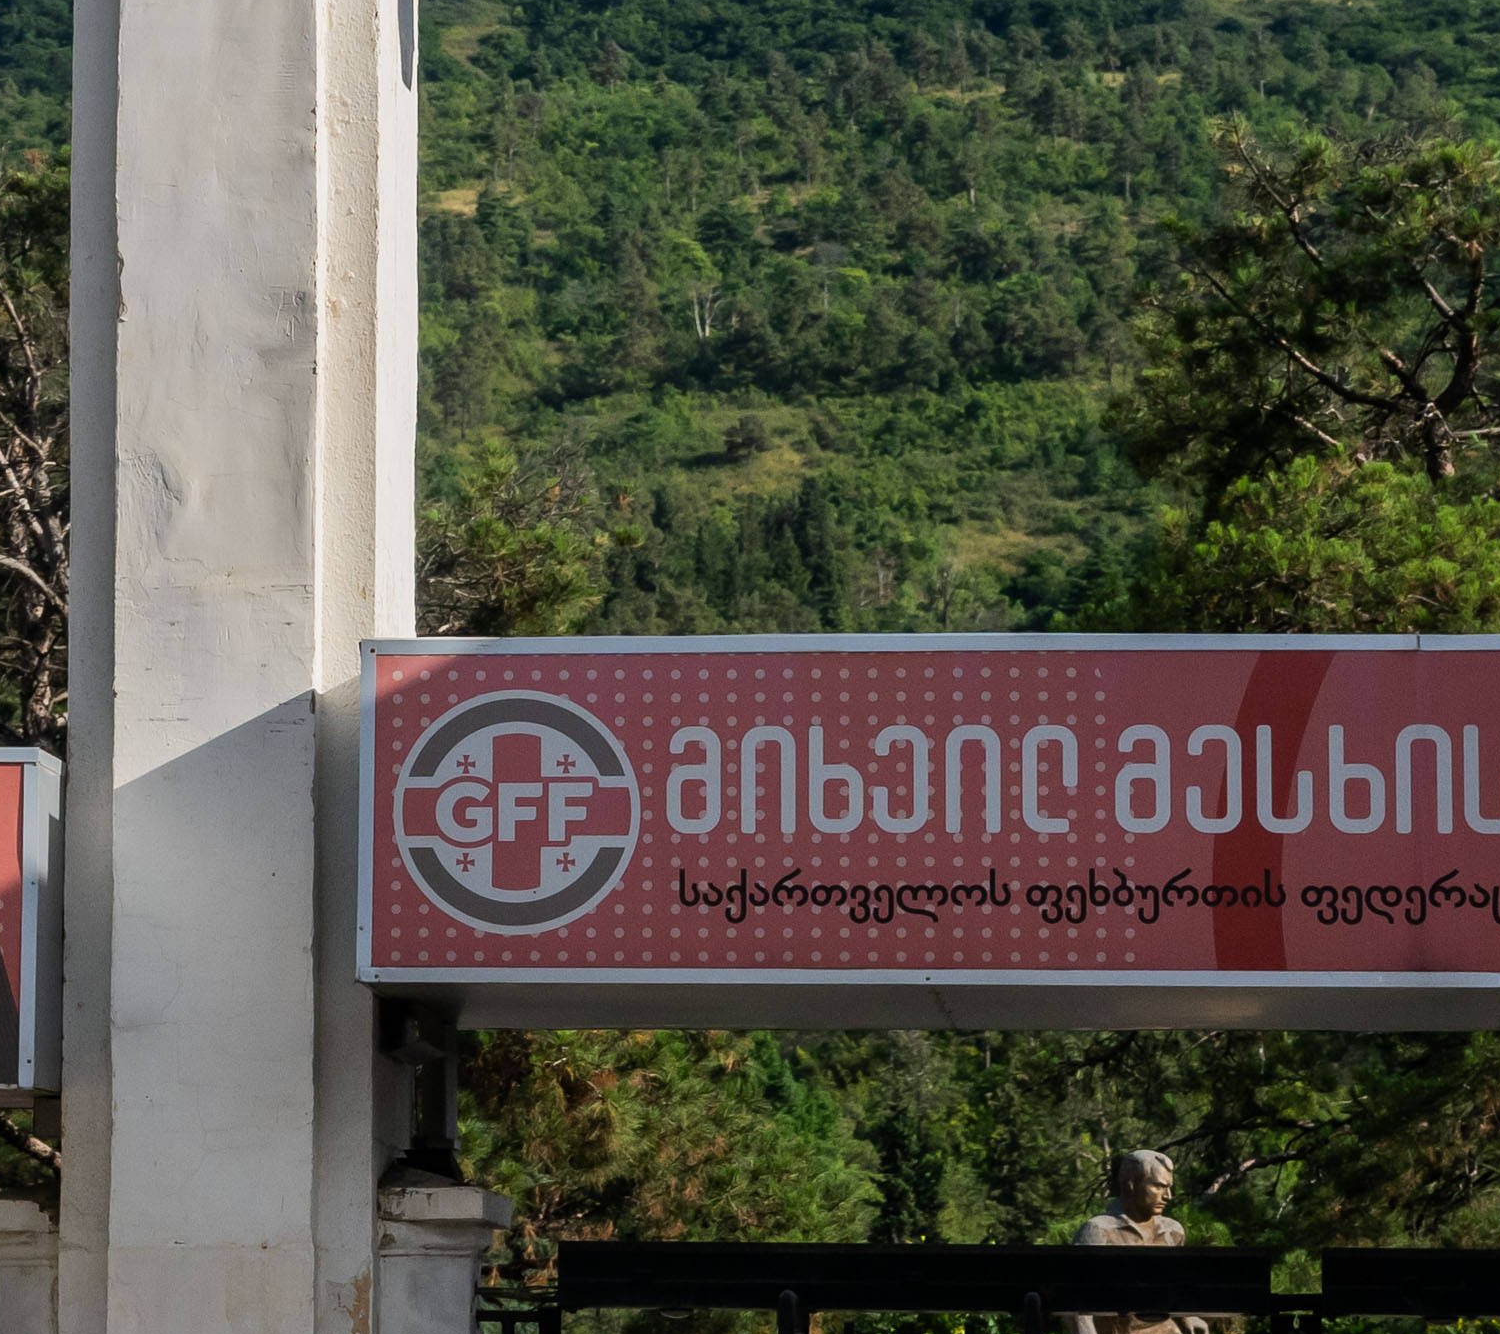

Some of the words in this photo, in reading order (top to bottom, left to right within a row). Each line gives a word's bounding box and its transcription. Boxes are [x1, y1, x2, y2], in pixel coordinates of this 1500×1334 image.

[664, 722, 1080, 836] მიხეილ
[433, 780, 595, 844] GFF
[677, 866, 1013, 926] საქართველოს
[1024, 866, 1289, 926] ფეხბურთის
